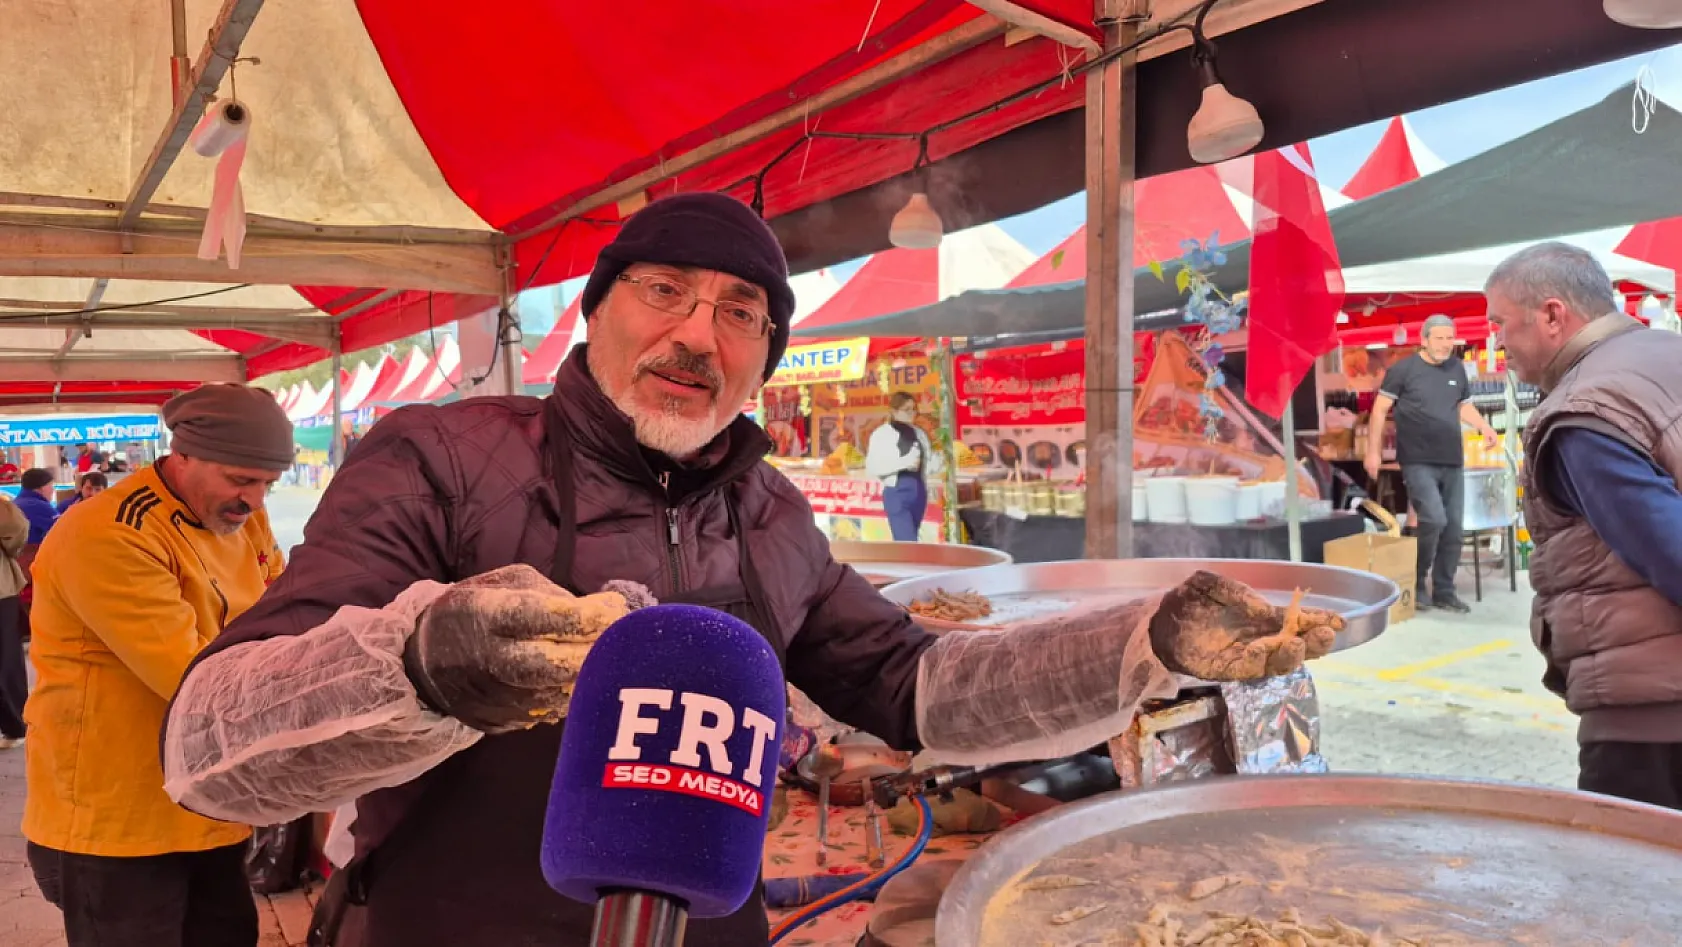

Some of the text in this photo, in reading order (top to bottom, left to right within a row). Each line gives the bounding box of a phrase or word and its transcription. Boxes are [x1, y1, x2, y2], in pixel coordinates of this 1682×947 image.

[778, 347, 850, 369] ANTEP
[608, 688, 776, 787] FRT
[613, 765, 759, 809] SED MEDYA
